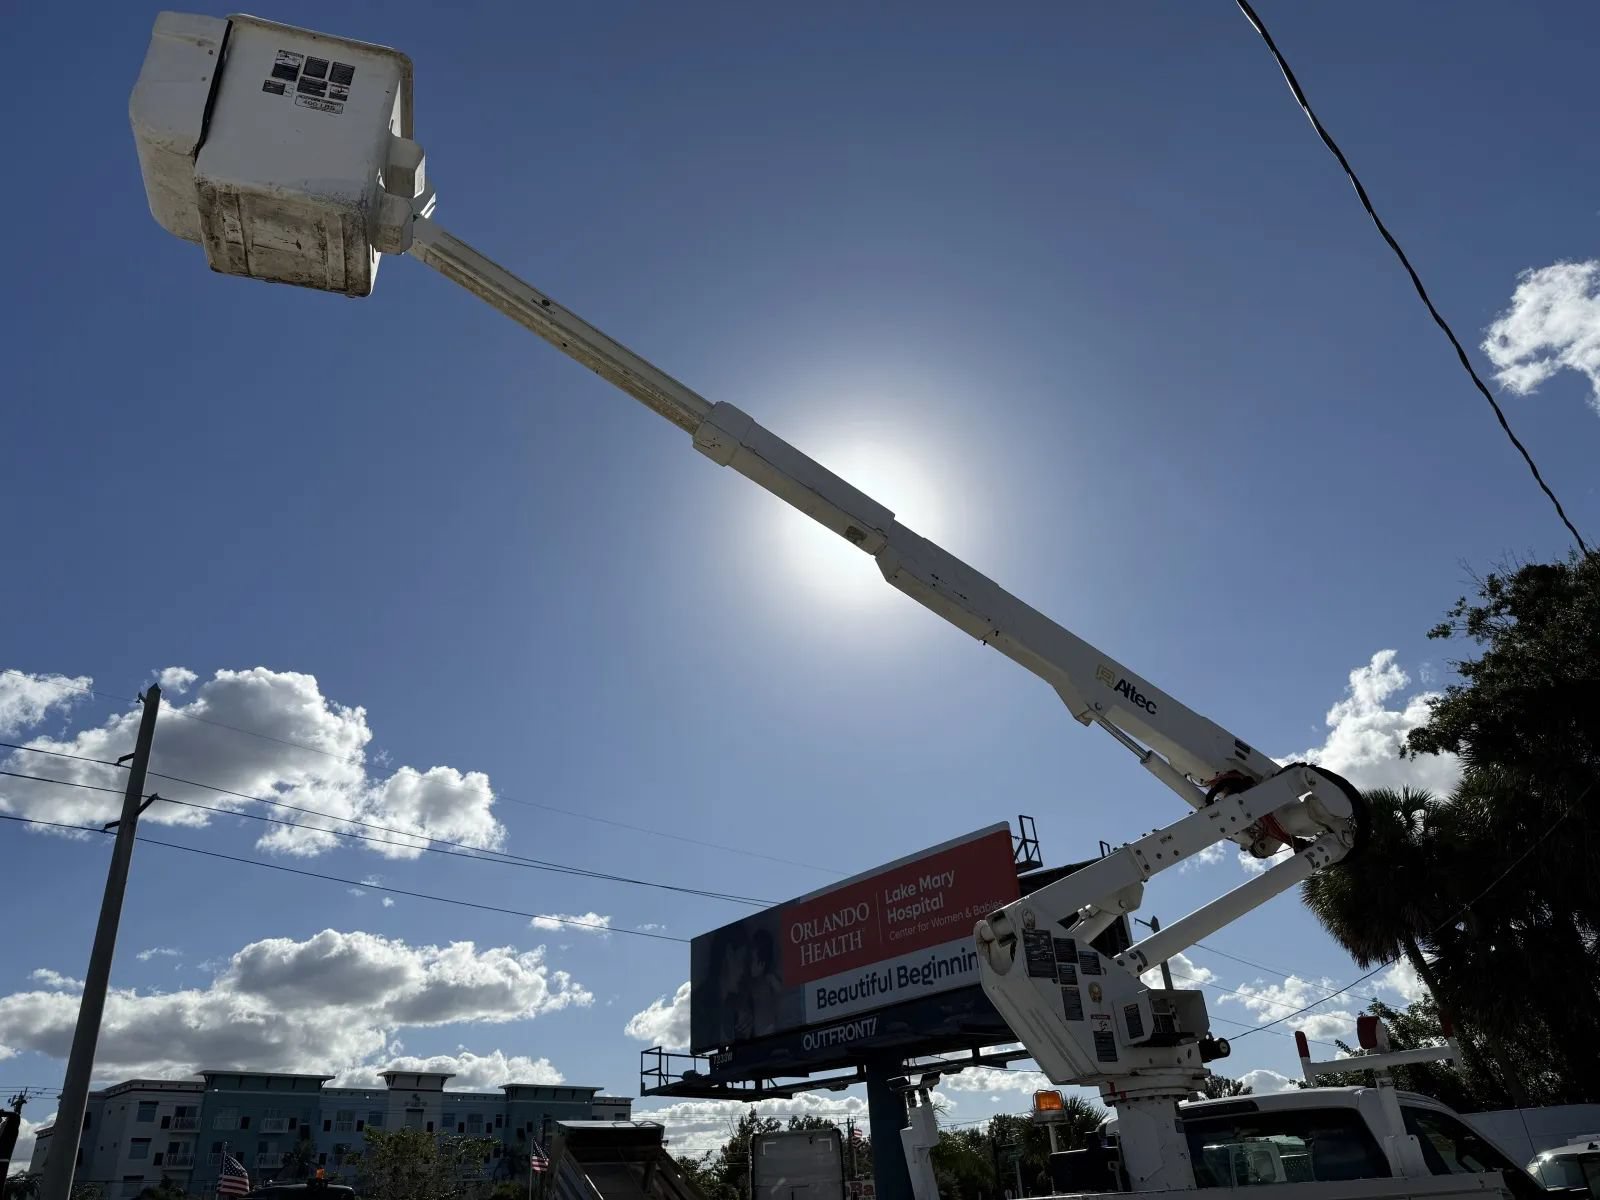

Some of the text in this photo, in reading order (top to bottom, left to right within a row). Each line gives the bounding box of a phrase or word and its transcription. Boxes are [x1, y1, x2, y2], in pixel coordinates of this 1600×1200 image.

[1113, 678, 1157, 715] Altec
[885, 870, 955, 904] Lake Mary
[790, 902, 870, 944] ORLANDO
[887, 893, 944, 924] Hospital
[889, 899, 1004, 941] Center for Women & Babies
[800, 930, 863, 966] HEALTH
[816, 968, 893, 1009] Beautiful
